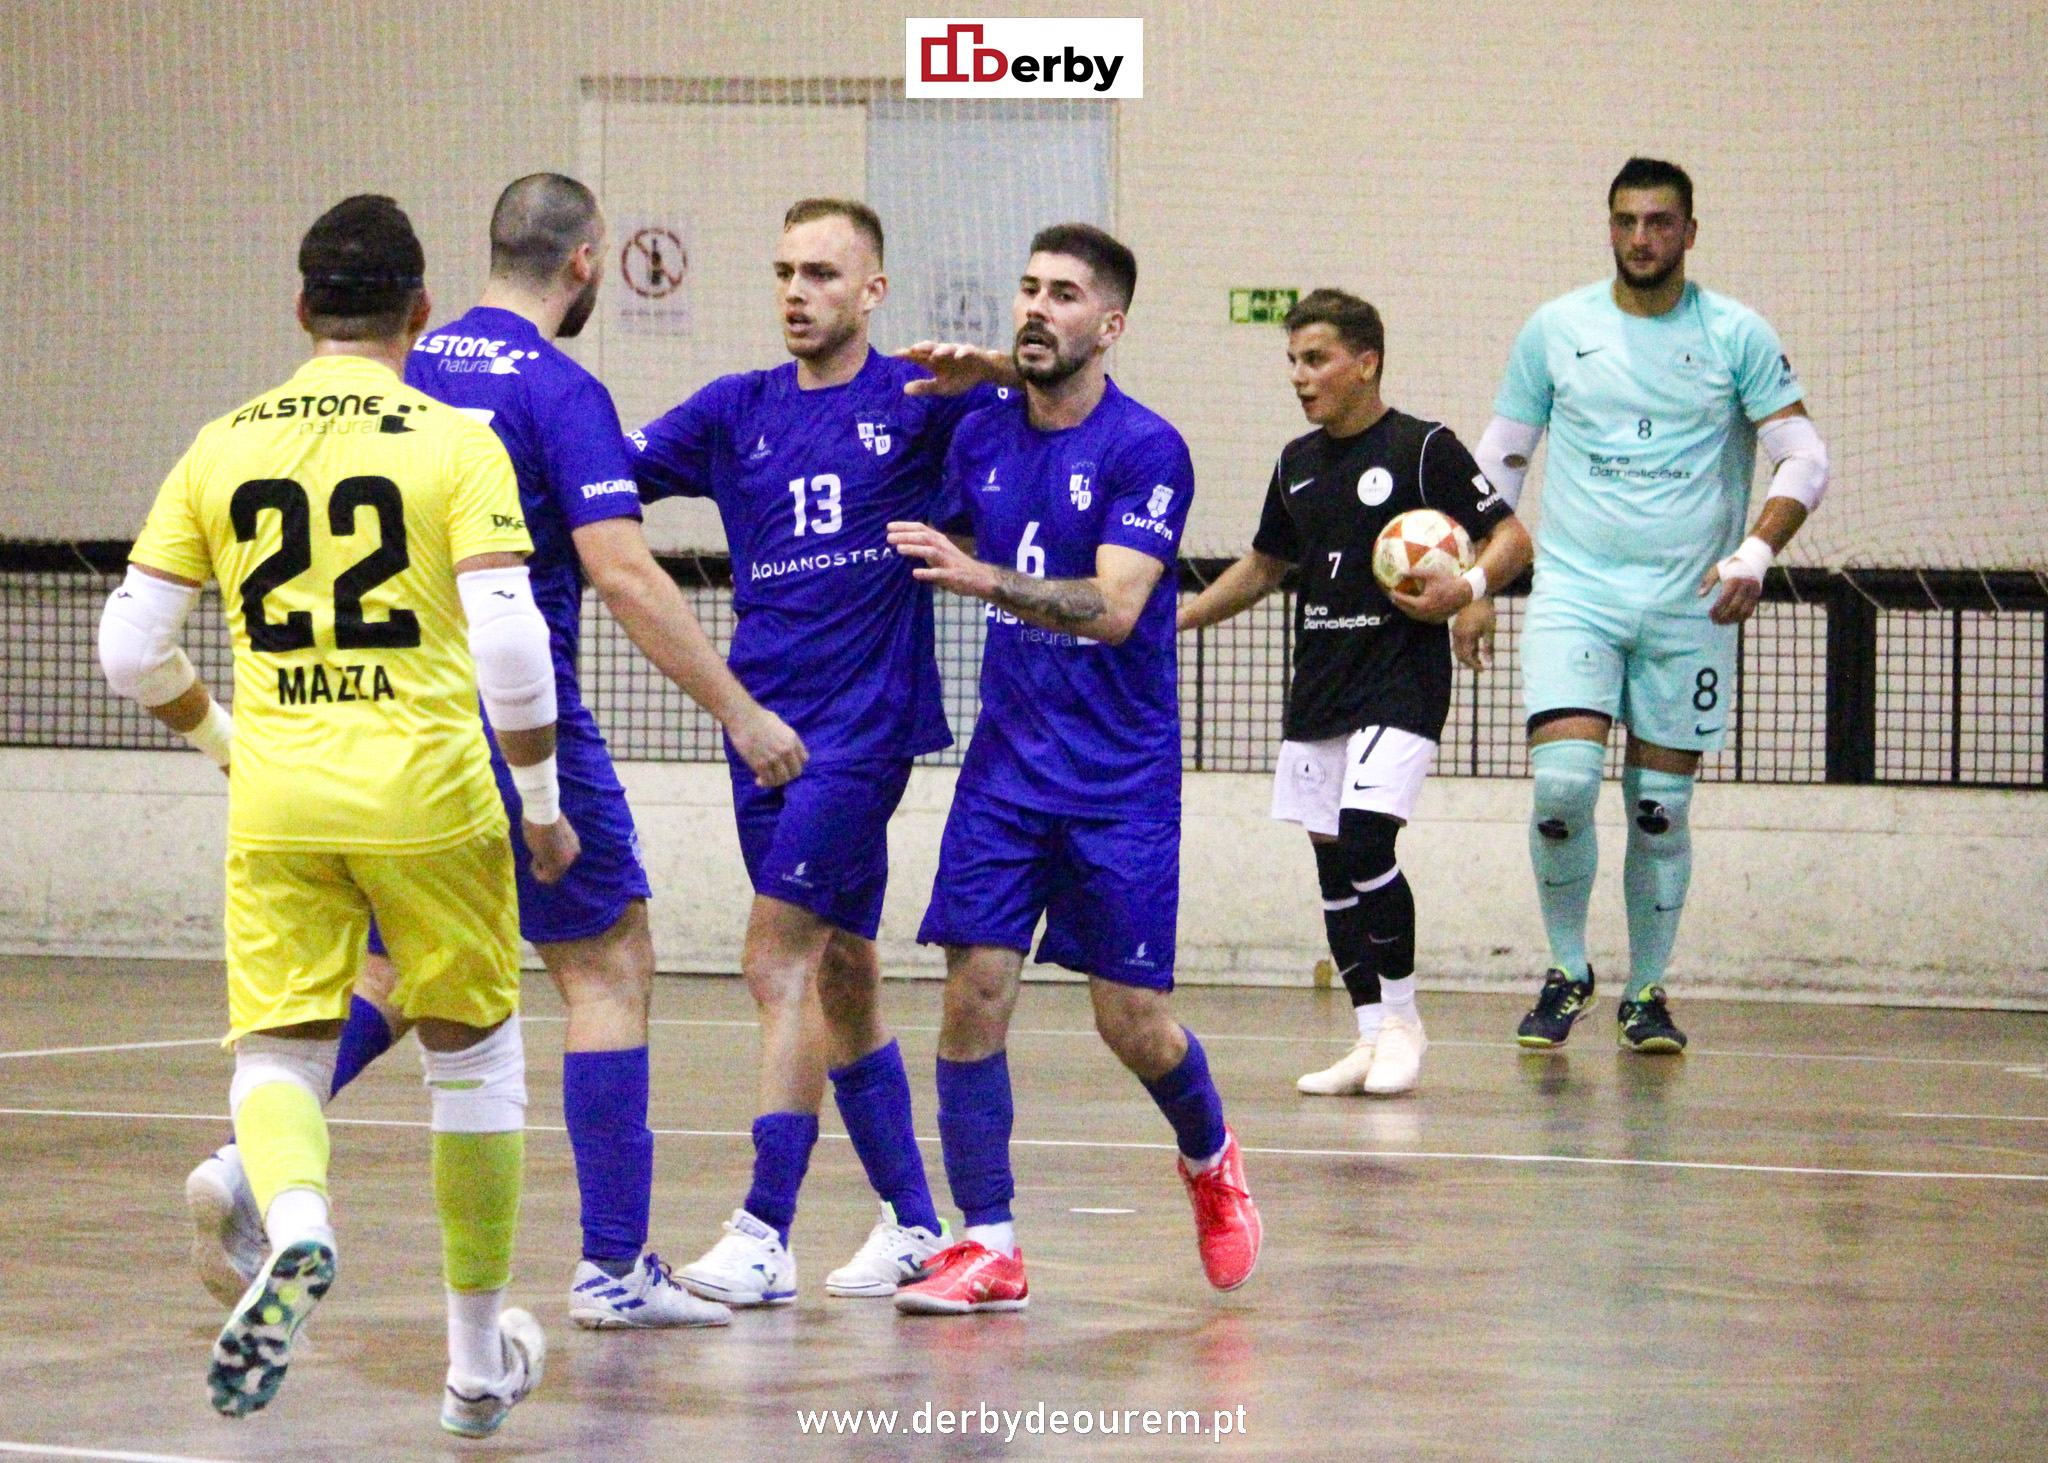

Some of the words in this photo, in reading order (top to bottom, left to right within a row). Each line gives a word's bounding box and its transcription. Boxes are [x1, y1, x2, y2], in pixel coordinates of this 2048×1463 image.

[413, 335, 507, 358] LSTONE
[438, 356, 495, 373] natural
[230, 394, 385, 428] FILSTONE
[300, 415, 382, 436] natural
[1638, 419, 1652, 440] 8
[581, 479, 639, 499] DIGIDE
[789, 473, 843, 537] 13
[1121, 512, 1173, 541] Ourém
[230, 475, 421, 652] 22
[751, 547, 894, 582] AQUANOSTRA
[1016, 520, 1045, 578] 6
[1328, 551, 1342, 579] 7
[277, 664, 395, 705] MAZZA
[1693, 667, 1719, 712] 8
